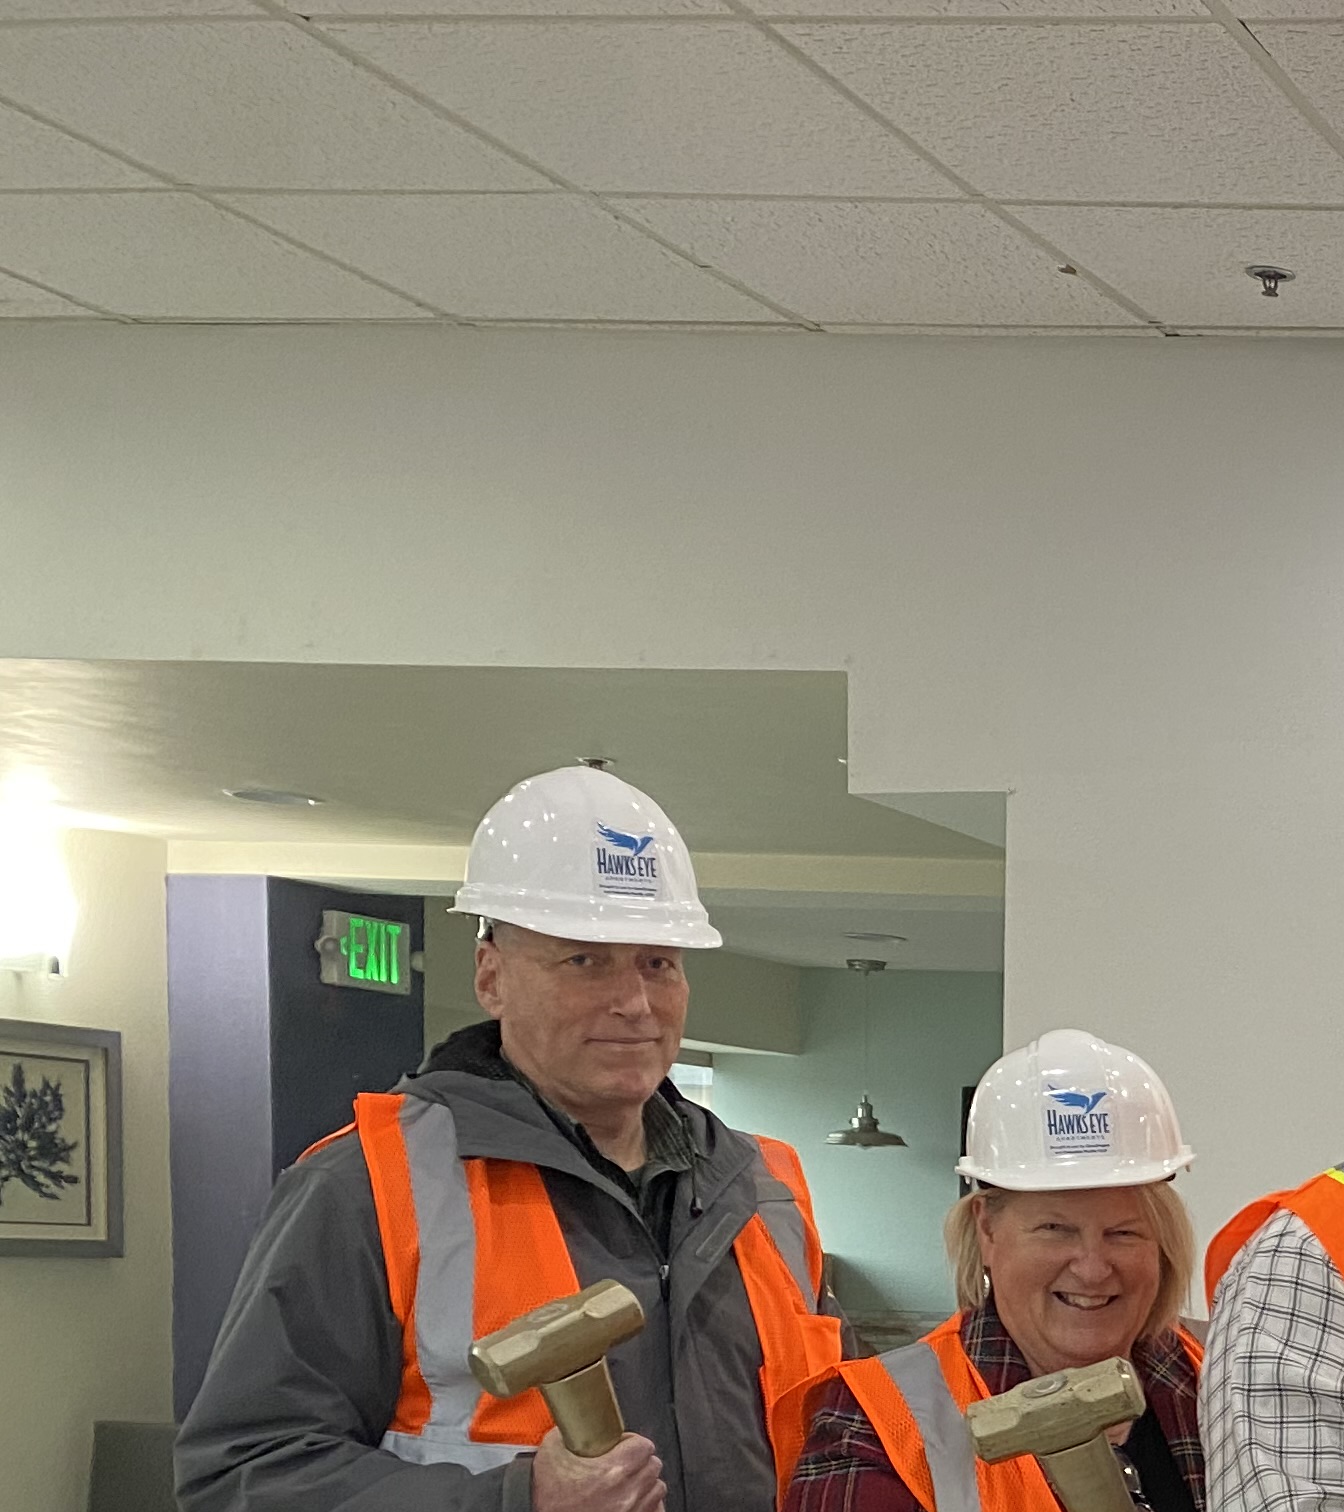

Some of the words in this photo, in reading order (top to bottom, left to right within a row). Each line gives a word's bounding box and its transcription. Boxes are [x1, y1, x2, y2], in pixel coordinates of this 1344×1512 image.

[638, 856, 657, 878] EYE
[349, 916, 402, 985] EXIT
[1089, 1112, 1110, 1134] EYE
